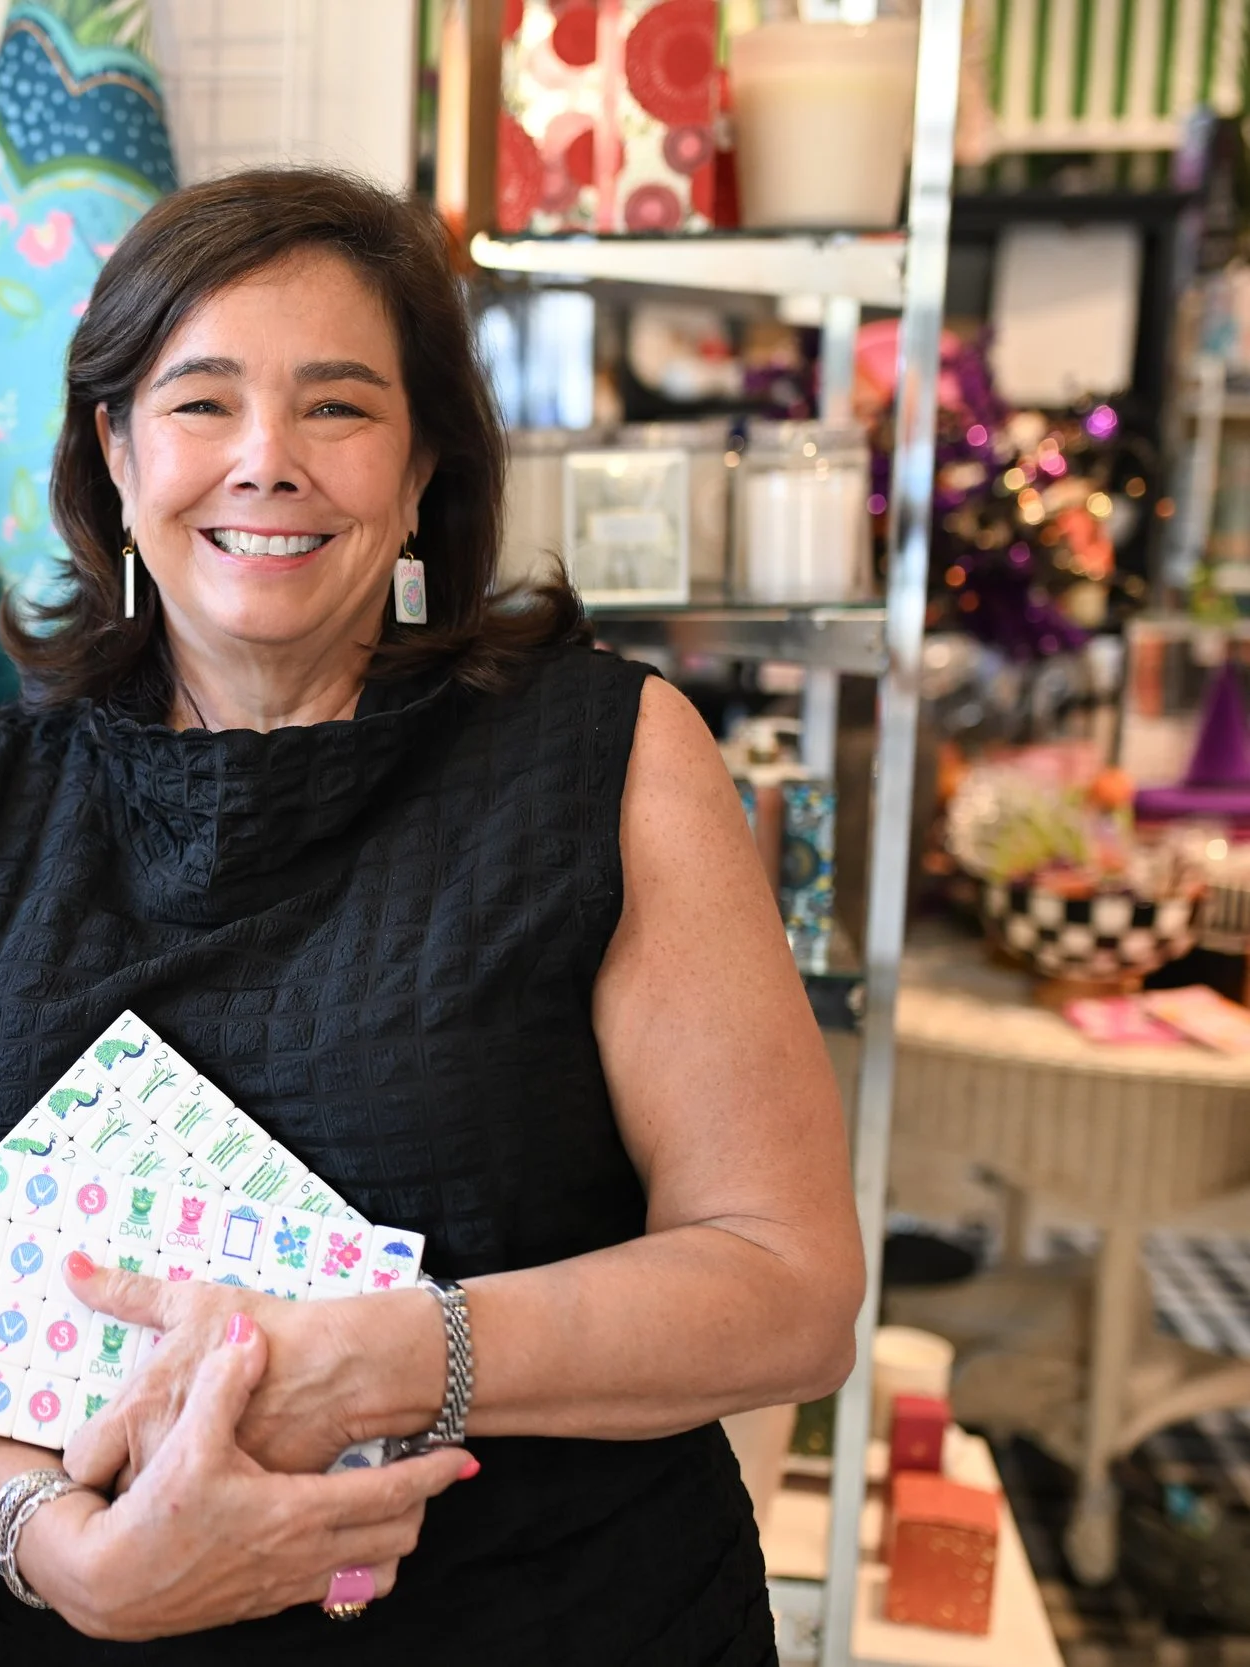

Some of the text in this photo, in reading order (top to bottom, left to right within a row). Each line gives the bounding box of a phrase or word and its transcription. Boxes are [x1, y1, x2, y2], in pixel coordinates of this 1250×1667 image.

[121, 1019, 132, 1031] 1
[154, 1050, 168, 1066] 2
[74, 1068, 85, 1080] 1
[190, 1082, 204, 1096] 3
[107, 1099, 122, 1115] 2
[28, 1118, 39, 1130] 1
[225, 1117, 238, 1129] 4
[144, 1130, 159, 1145] 3
[62, 1149, 76, 1163] 2
[262, 1146, 277, 1161] 5
[179, 1166, 192, 1179] 4
[301, 1180, 312, 1195] 6
[119, 1222, 152, 1241] BAM
[166, 1231, 206, 1252] CRAK
[89, 1359, 123, 1379] BAM
